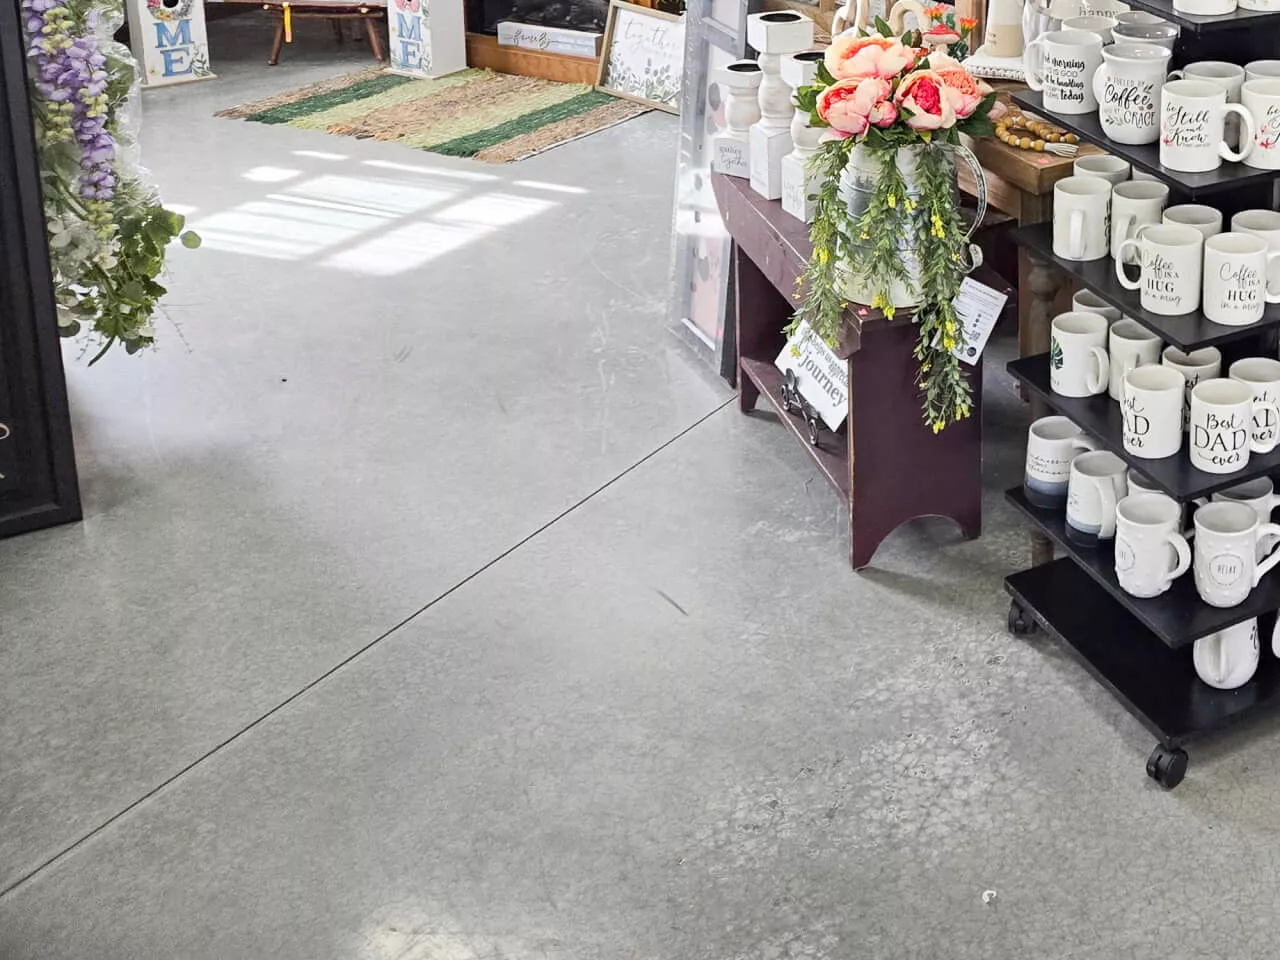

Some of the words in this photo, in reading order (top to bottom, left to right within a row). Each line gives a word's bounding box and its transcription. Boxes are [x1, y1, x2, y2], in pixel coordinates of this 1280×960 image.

[1105, 83, 1150, 109] Coffee
[1123, 110, 1156, 128] GRACE
[1142, 249, 1175, 280] Coffee
[1219, 262, 1257, 289] Coffee
[1147, 278, 1175, 293] HUG
[1228, 290, 1257, 301] HUG
[798, 351, 848, 407] journey
[1207, 413, 1244, 430] Best
[1194, 424, 1247, 452] DAD
[1211, 453, 1241, 466] ever
